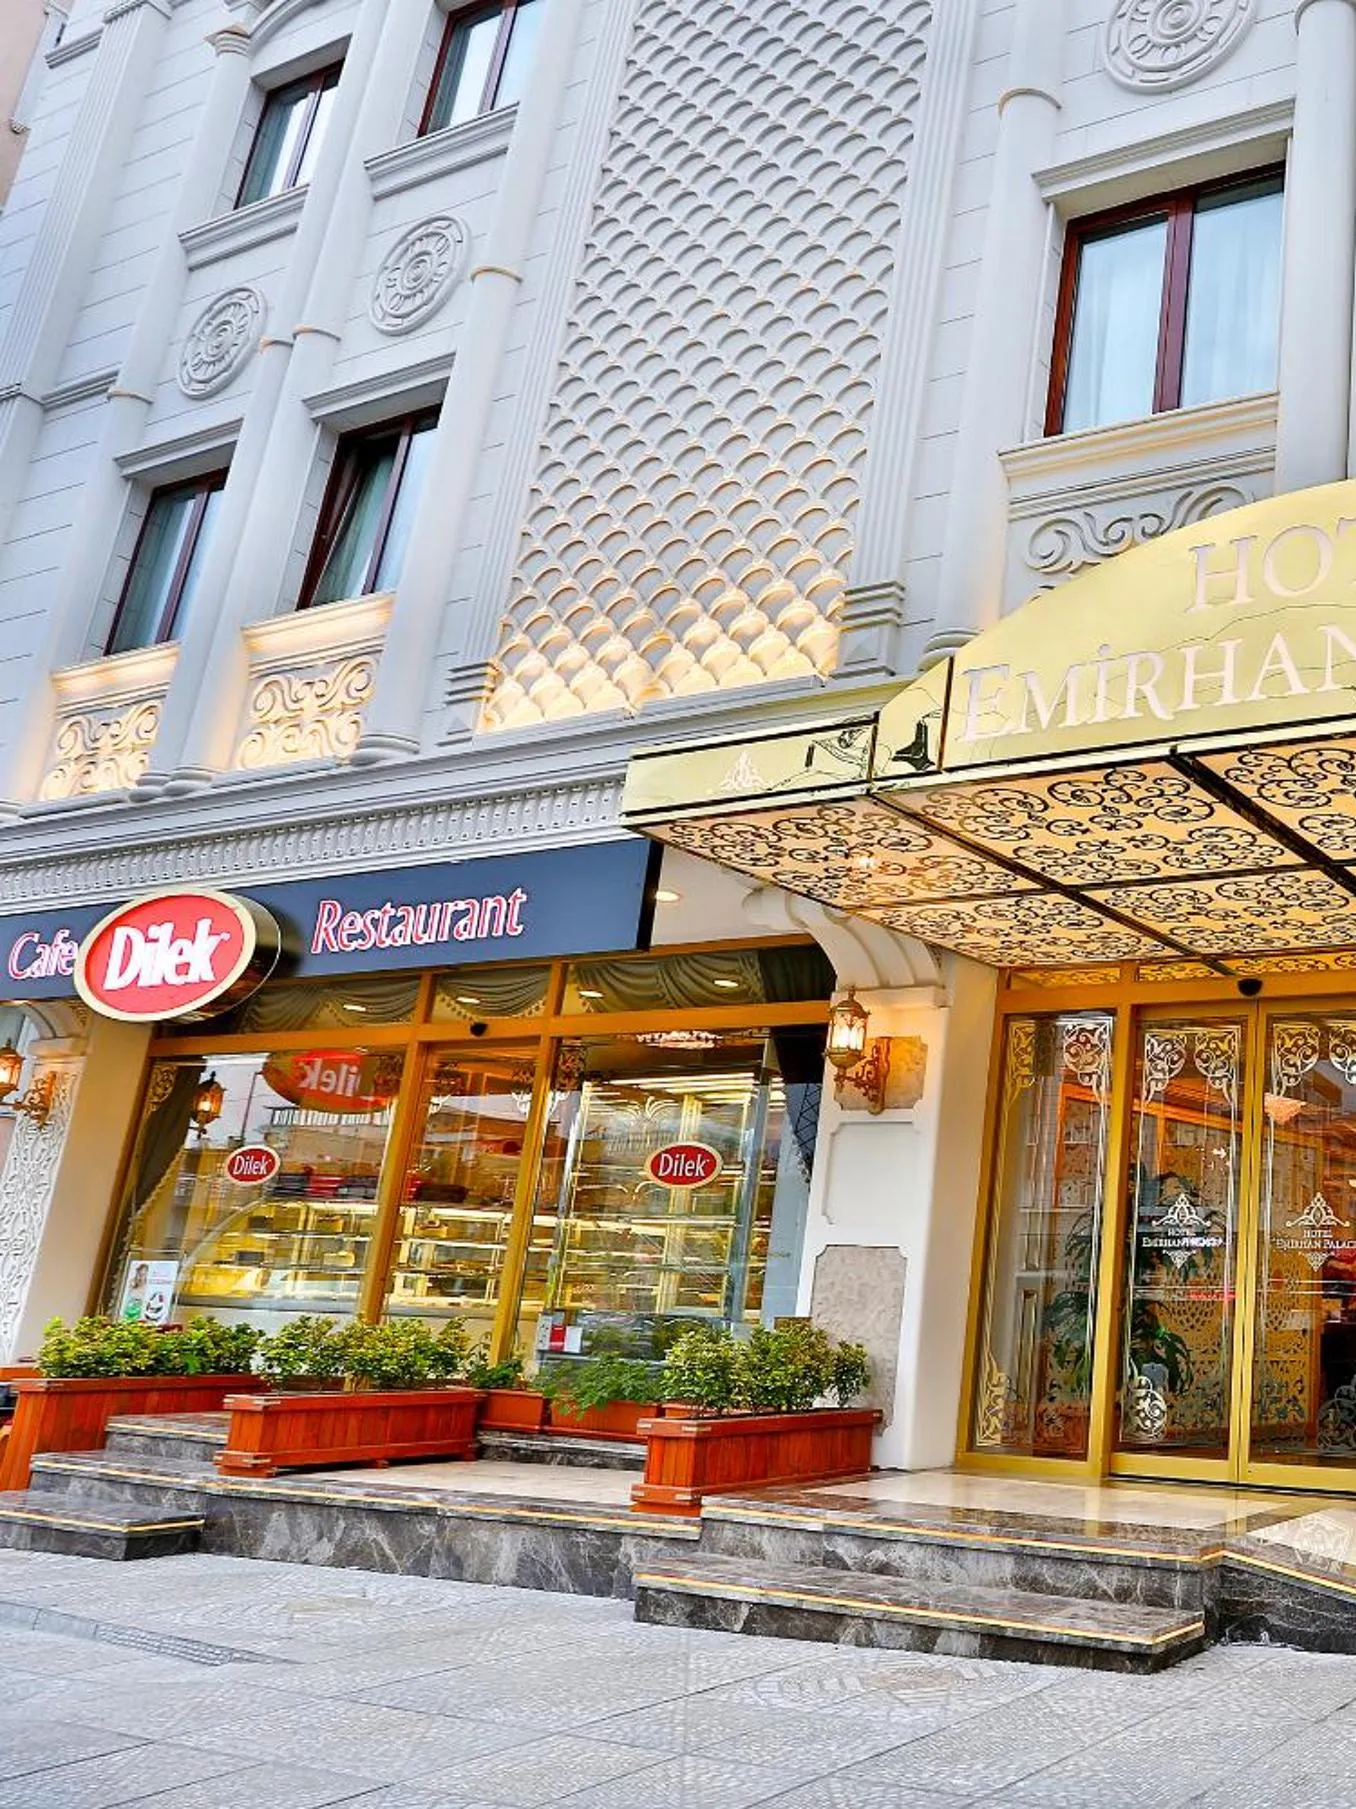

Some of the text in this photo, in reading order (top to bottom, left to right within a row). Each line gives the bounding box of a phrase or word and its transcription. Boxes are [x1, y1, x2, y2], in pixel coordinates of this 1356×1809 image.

[311, 888, 527, 954] Restaurant
[8, 928, 79, 980] Cafe
[103, 917, 222, 990] Dilek
[232, 1154, 269, 1175] Dilek
[658, 1153, 706, 1177] Dilek
[1303, 1229, 1333, 1239] HOTEL
